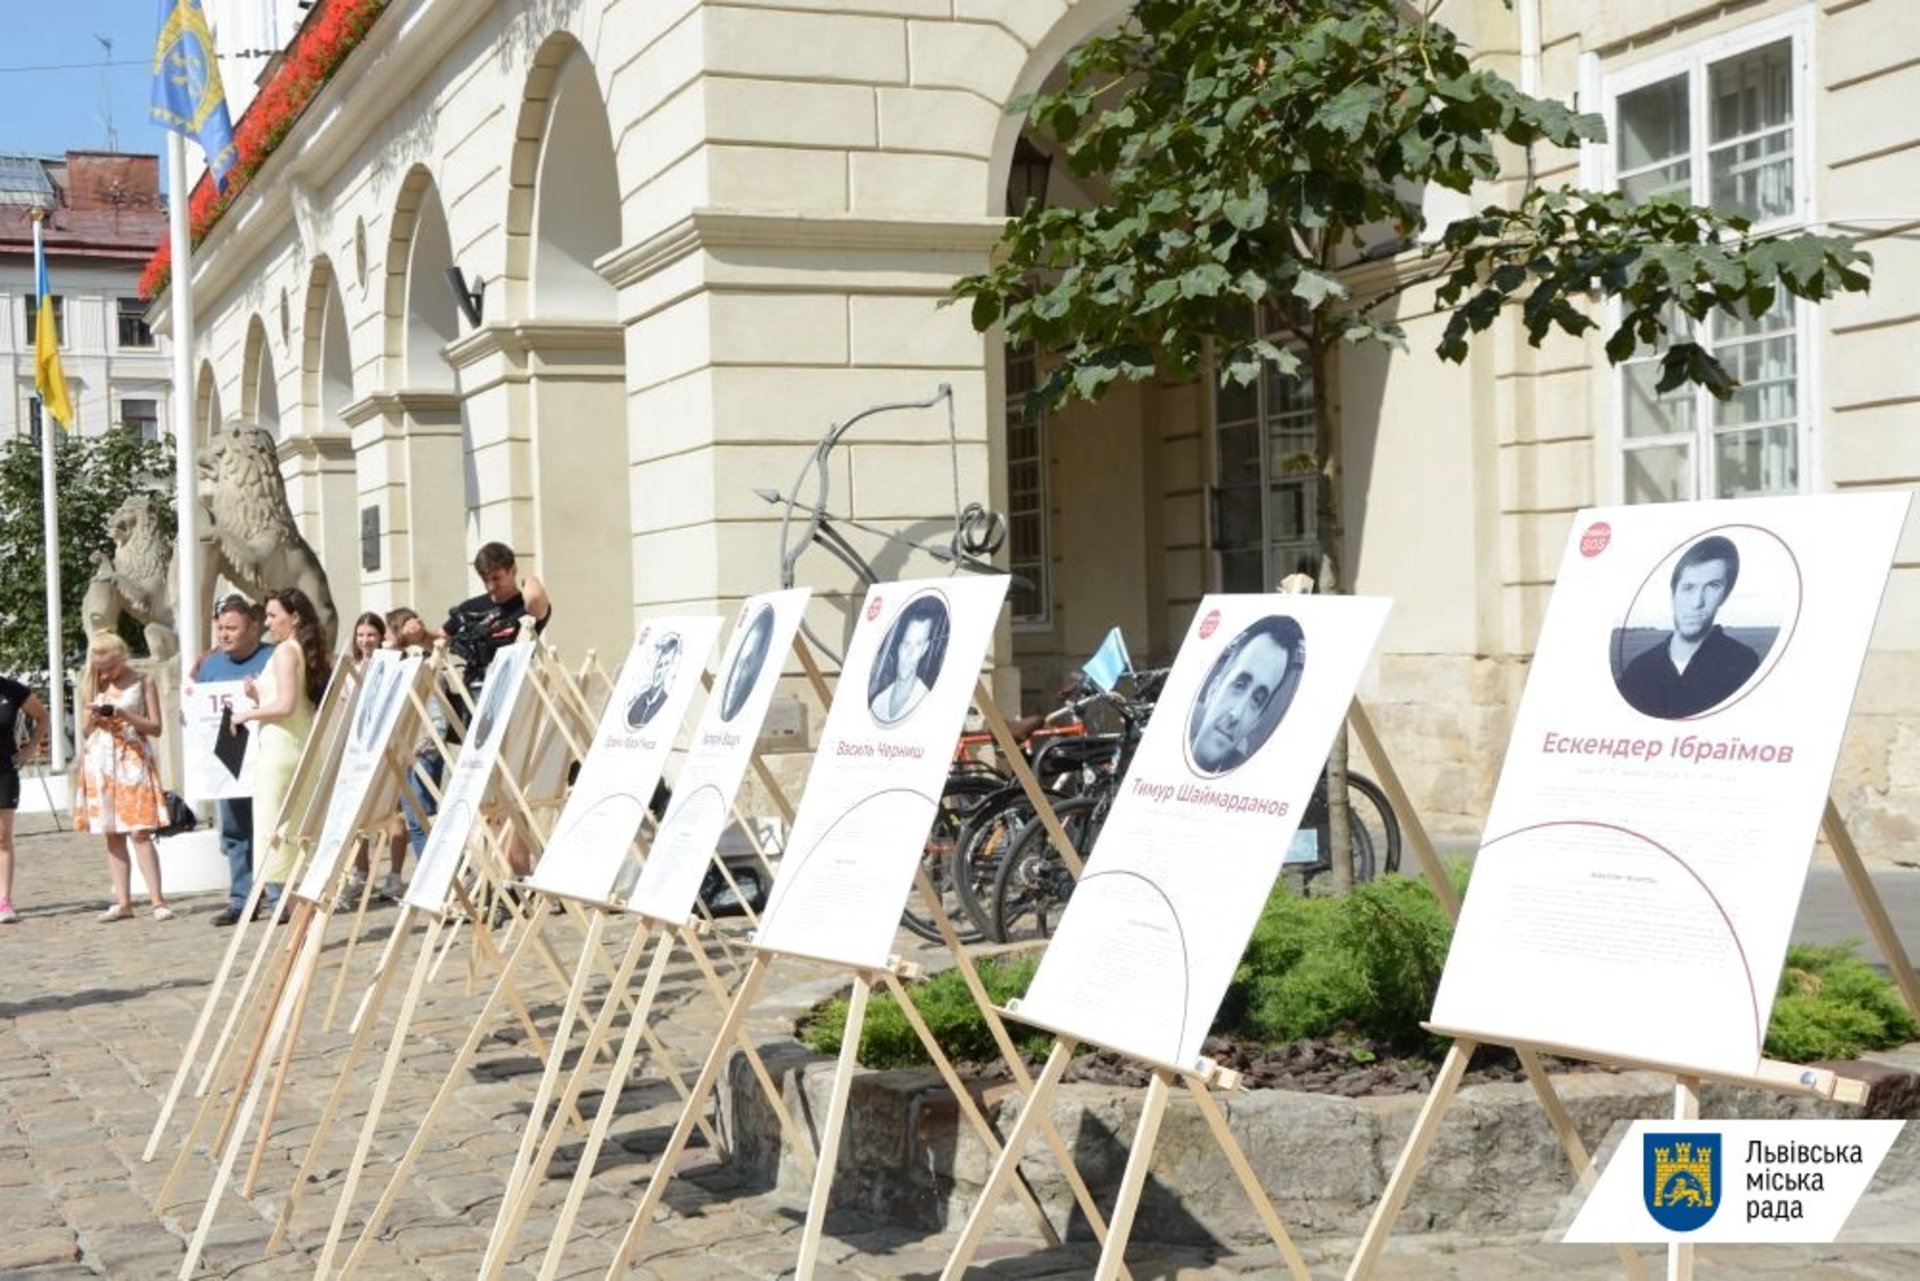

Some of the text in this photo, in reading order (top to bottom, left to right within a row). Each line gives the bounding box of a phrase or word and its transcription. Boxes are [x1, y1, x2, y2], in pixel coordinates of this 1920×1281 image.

[1542, 732, 1795, 764] Ескендер Ібраїмов
[1132, 777, 1290, 817] Тимур Шаймарданов
